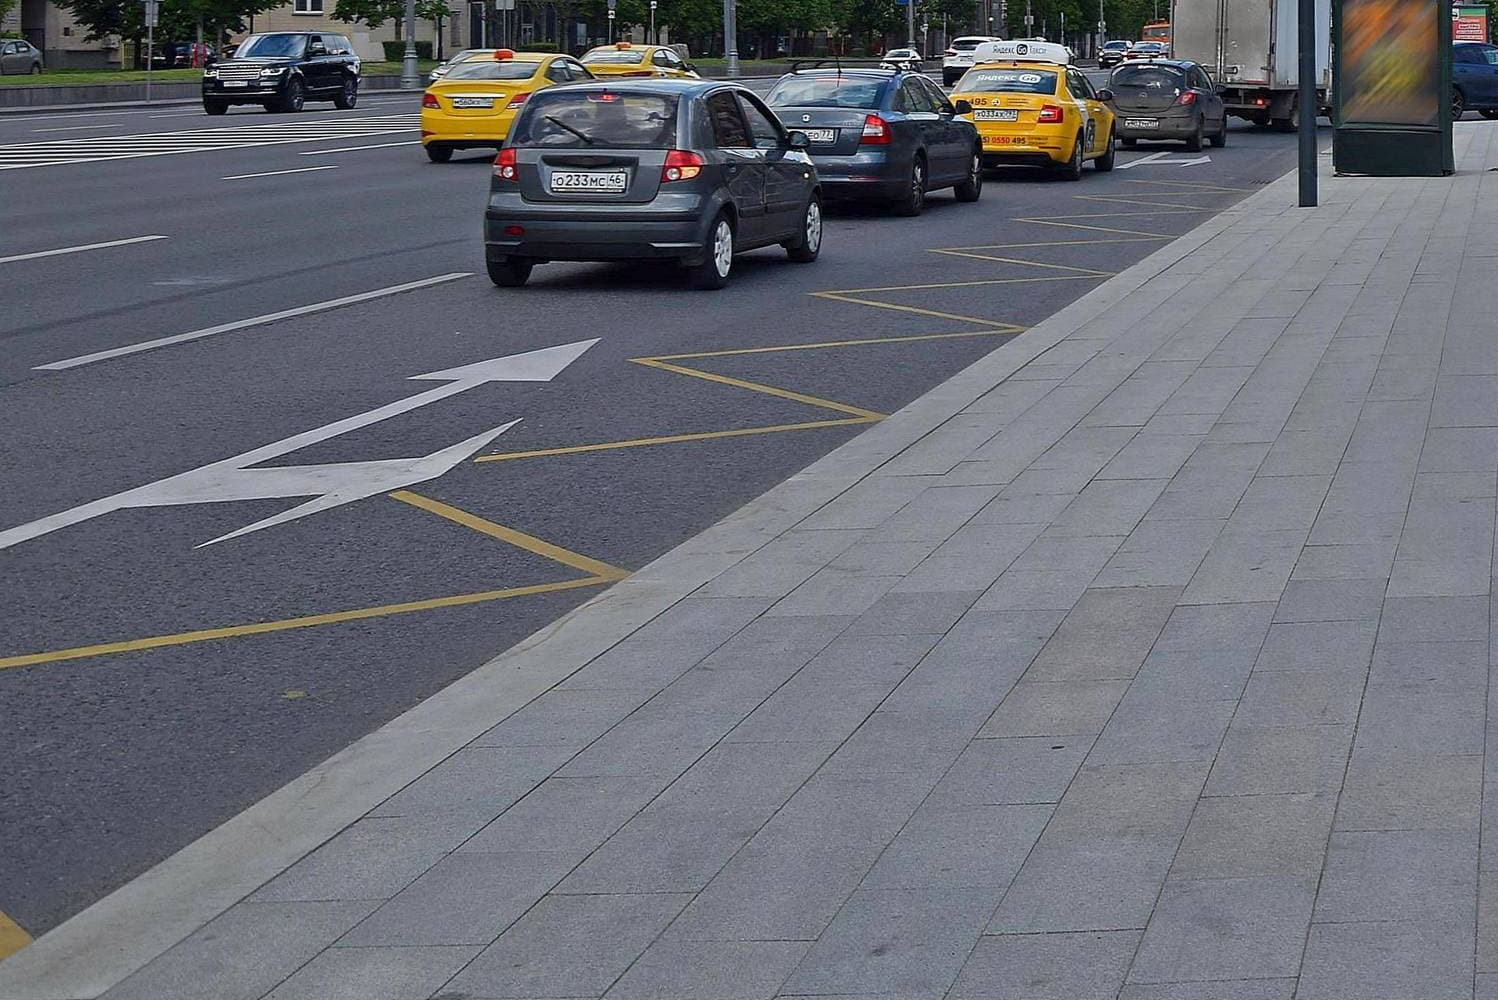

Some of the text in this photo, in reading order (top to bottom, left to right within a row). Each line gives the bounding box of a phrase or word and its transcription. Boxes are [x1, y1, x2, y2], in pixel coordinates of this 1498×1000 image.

[992, 45, 1015, 54] Яндекс
[991, 136, 1010, 144] 0550
[556, 174, 606, 187] О233МС
